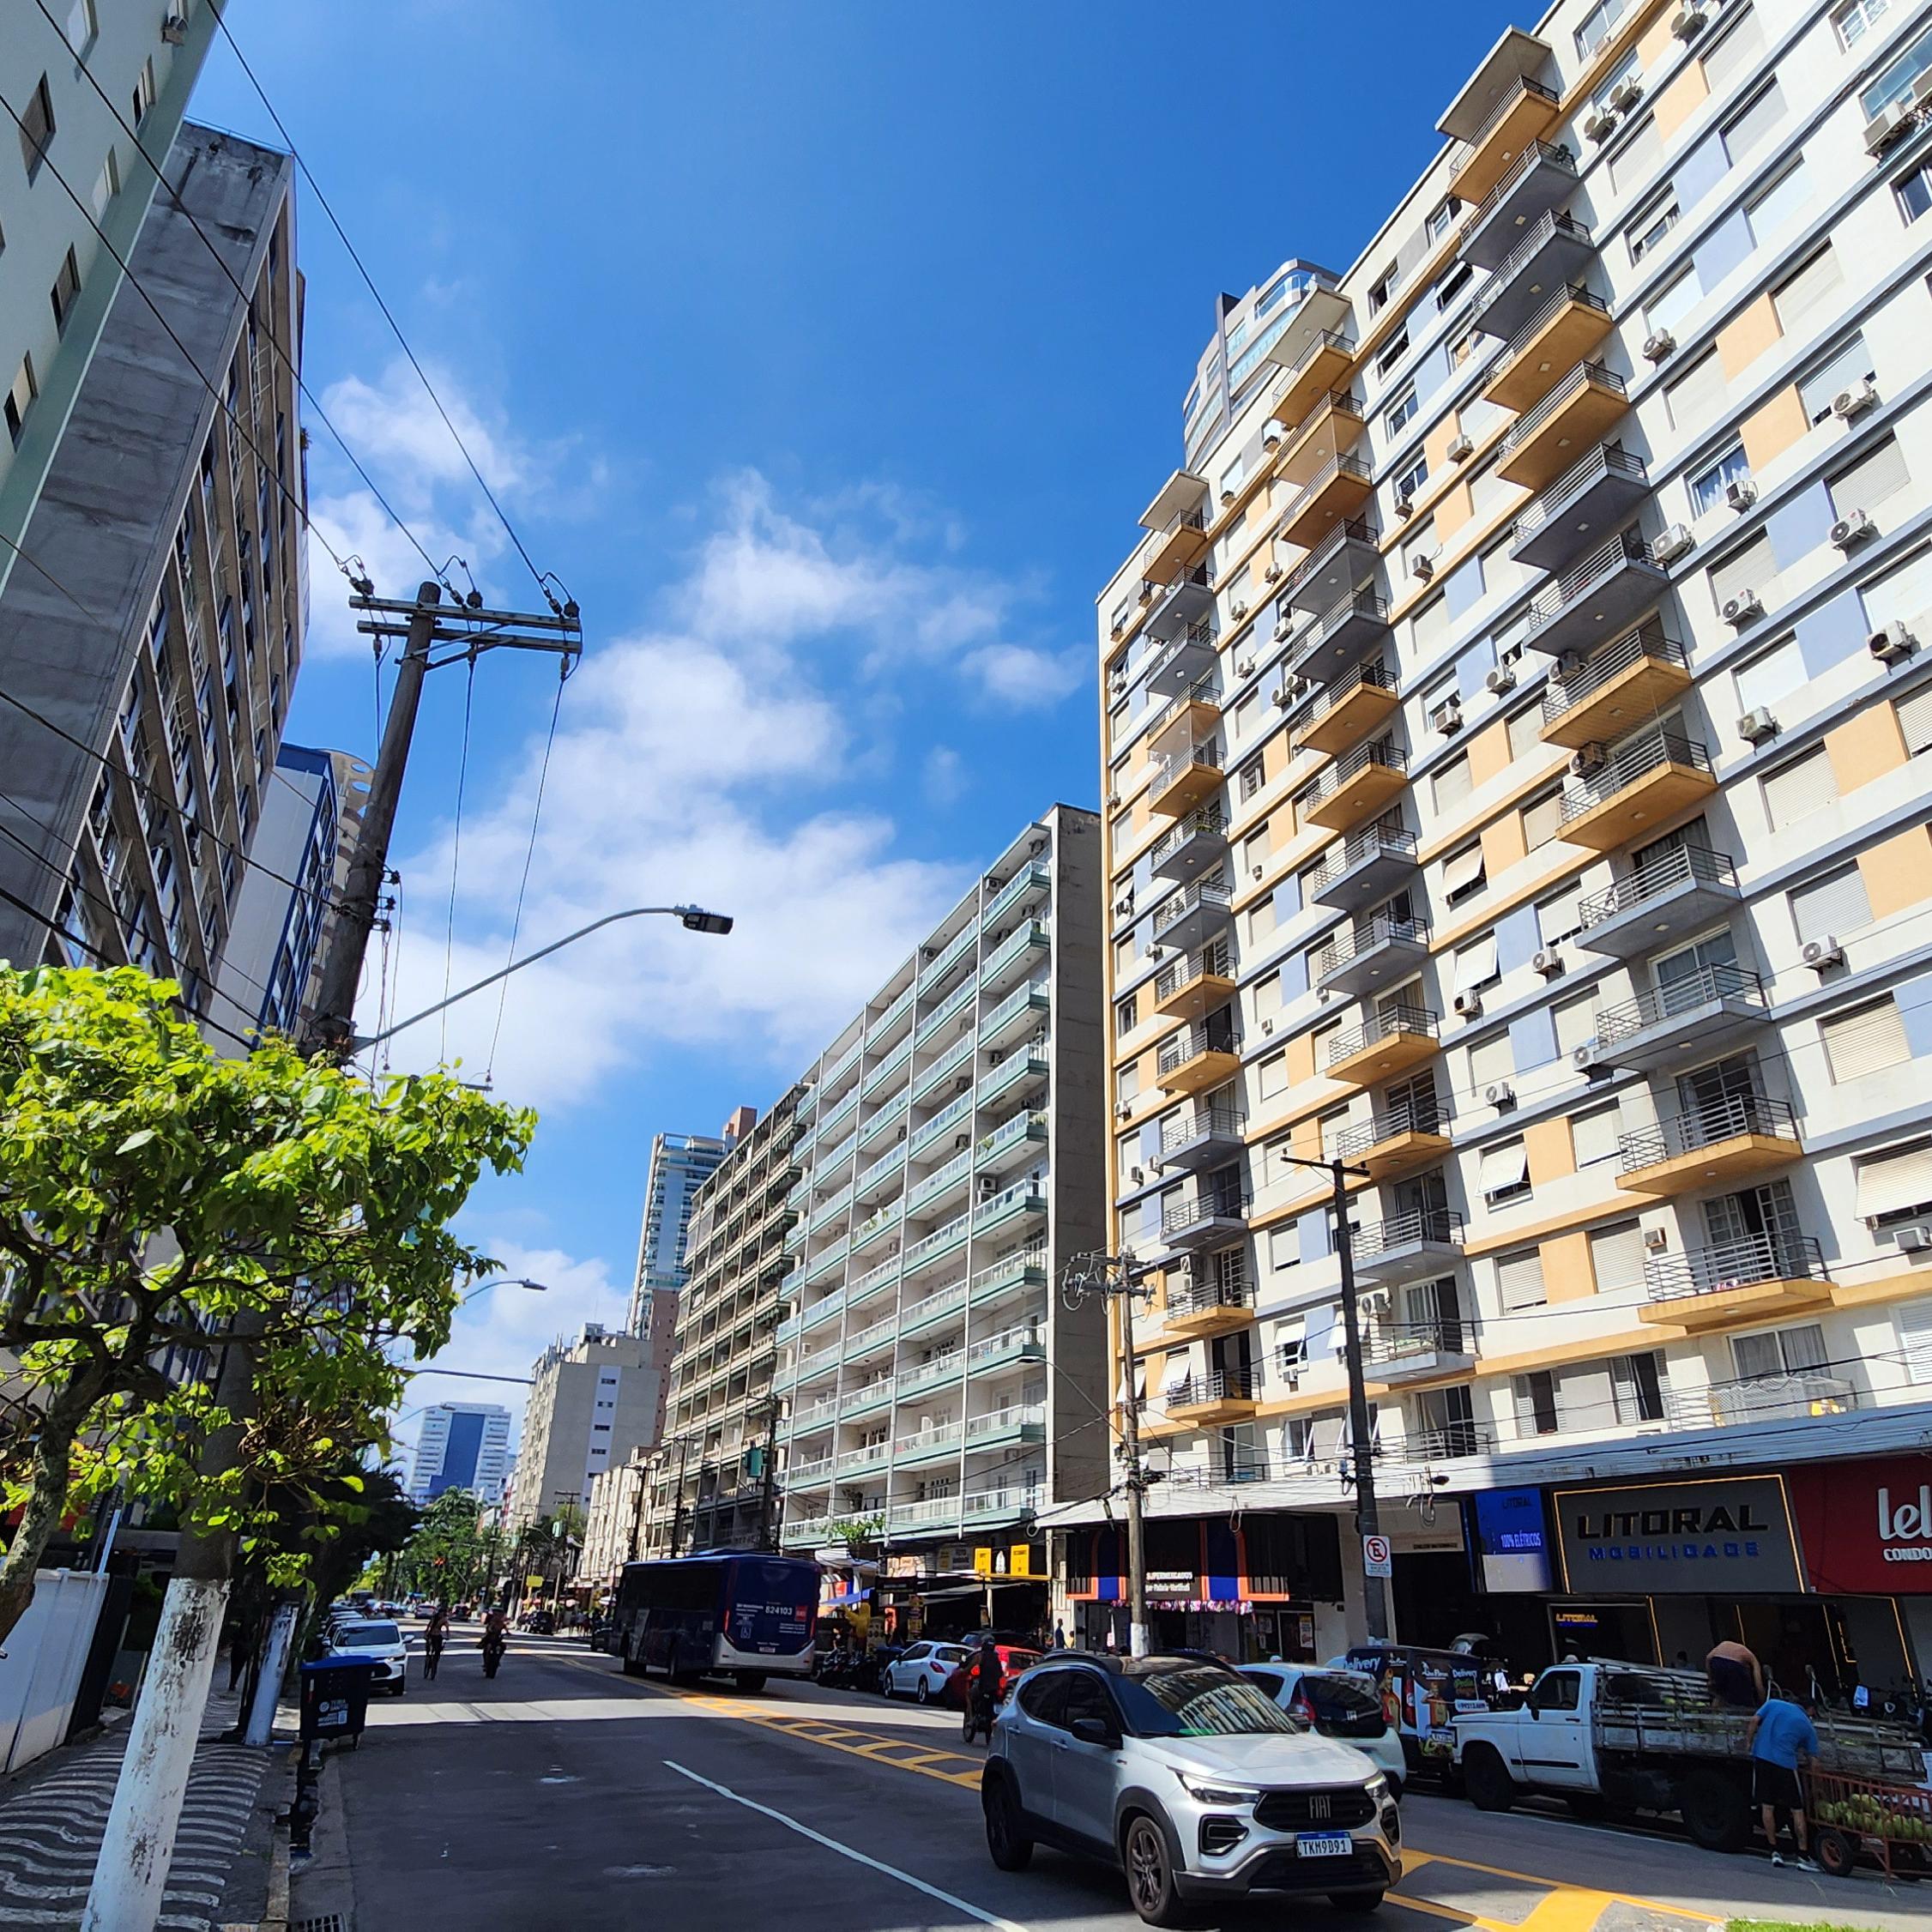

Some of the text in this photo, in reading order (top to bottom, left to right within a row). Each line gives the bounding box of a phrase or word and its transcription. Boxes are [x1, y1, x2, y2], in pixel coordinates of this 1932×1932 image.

[1578, 1505, 1770, 1539] LITORAL
[1500, 1534, 1514, 1548] 100%
[1514, 1530, 1542, 1548] ELÉTRICOS
[1589, 1542, 1760, 1561] MOBILIDADE
[765, 1605, 793, 1615] 824103
[1555, 1613, 1598, 1623] LITORAL
[1309, 1795, 1331, 1819] FIAT
